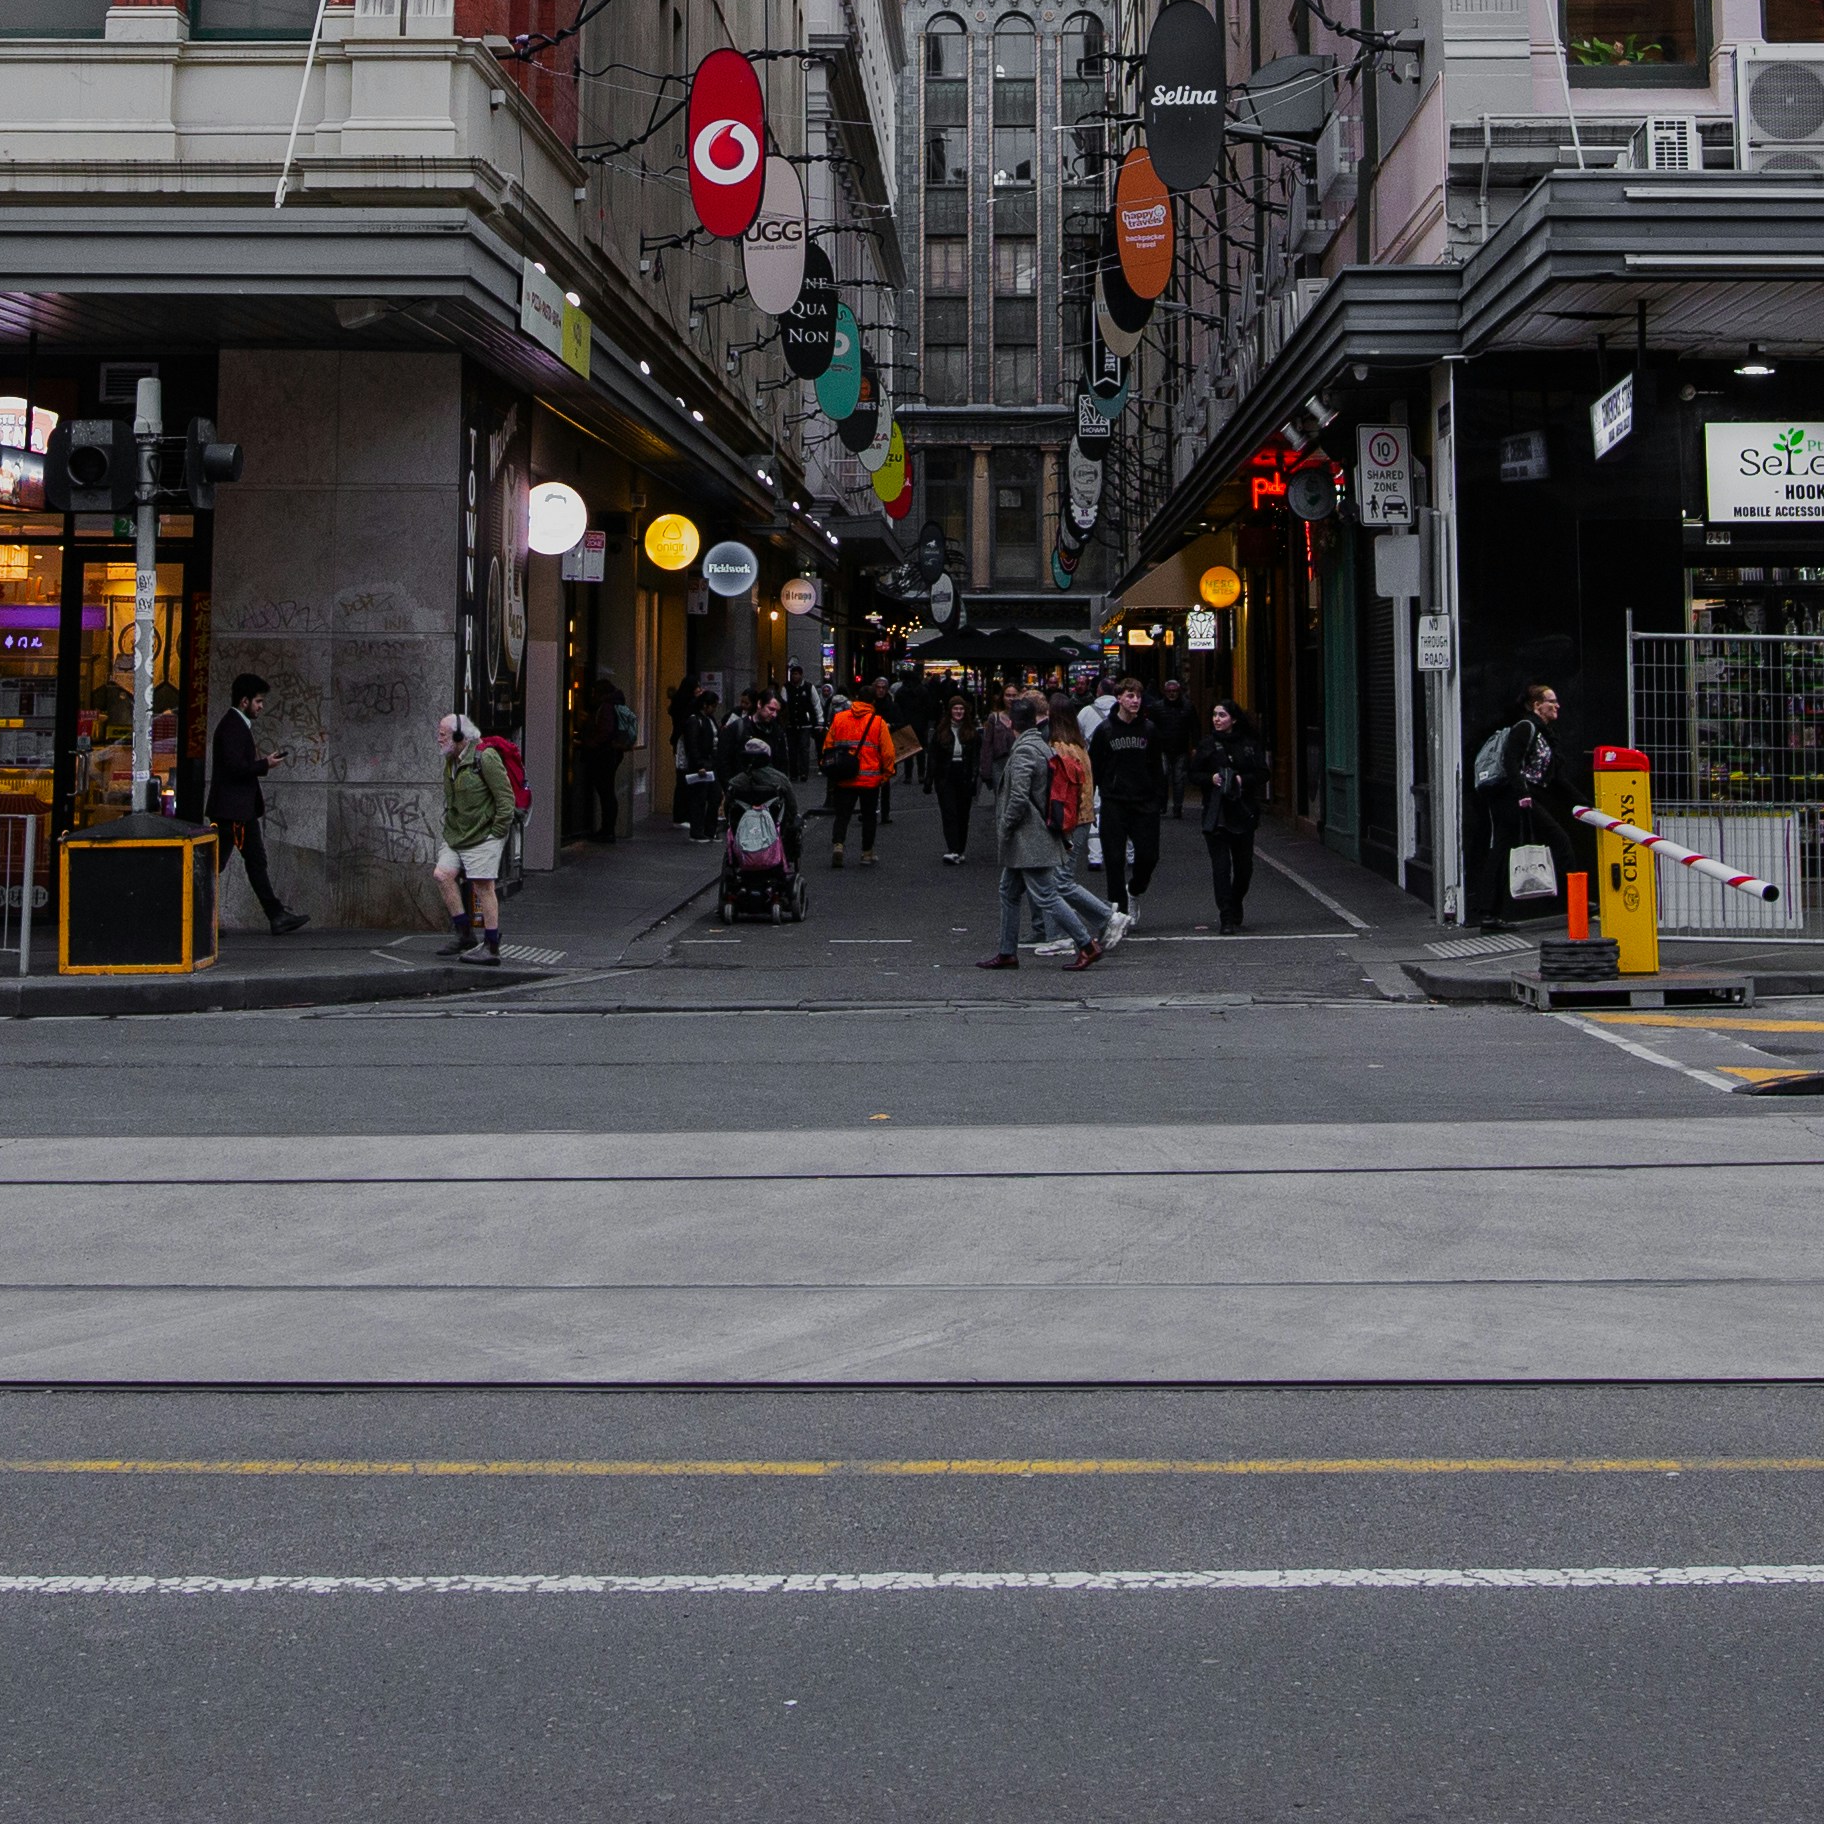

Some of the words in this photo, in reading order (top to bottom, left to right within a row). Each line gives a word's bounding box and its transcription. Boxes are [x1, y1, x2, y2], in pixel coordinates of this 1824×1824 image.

[1151, 84, 1218, 106] Selina
[744, 220, 803, 243] UGG
[1376, 441, 1391, 458] 10
[1366, 469, 1404, 481] SHARED
[1373, 482, 1398, 493] ZONE
[1733, 506, 1772, 518] MOBILE
[708, 563, 752, 574] Fieldwork
[1420, 635, 1449, 649] THROUGH
[1621, 793, 1638, 882] CENSYS
